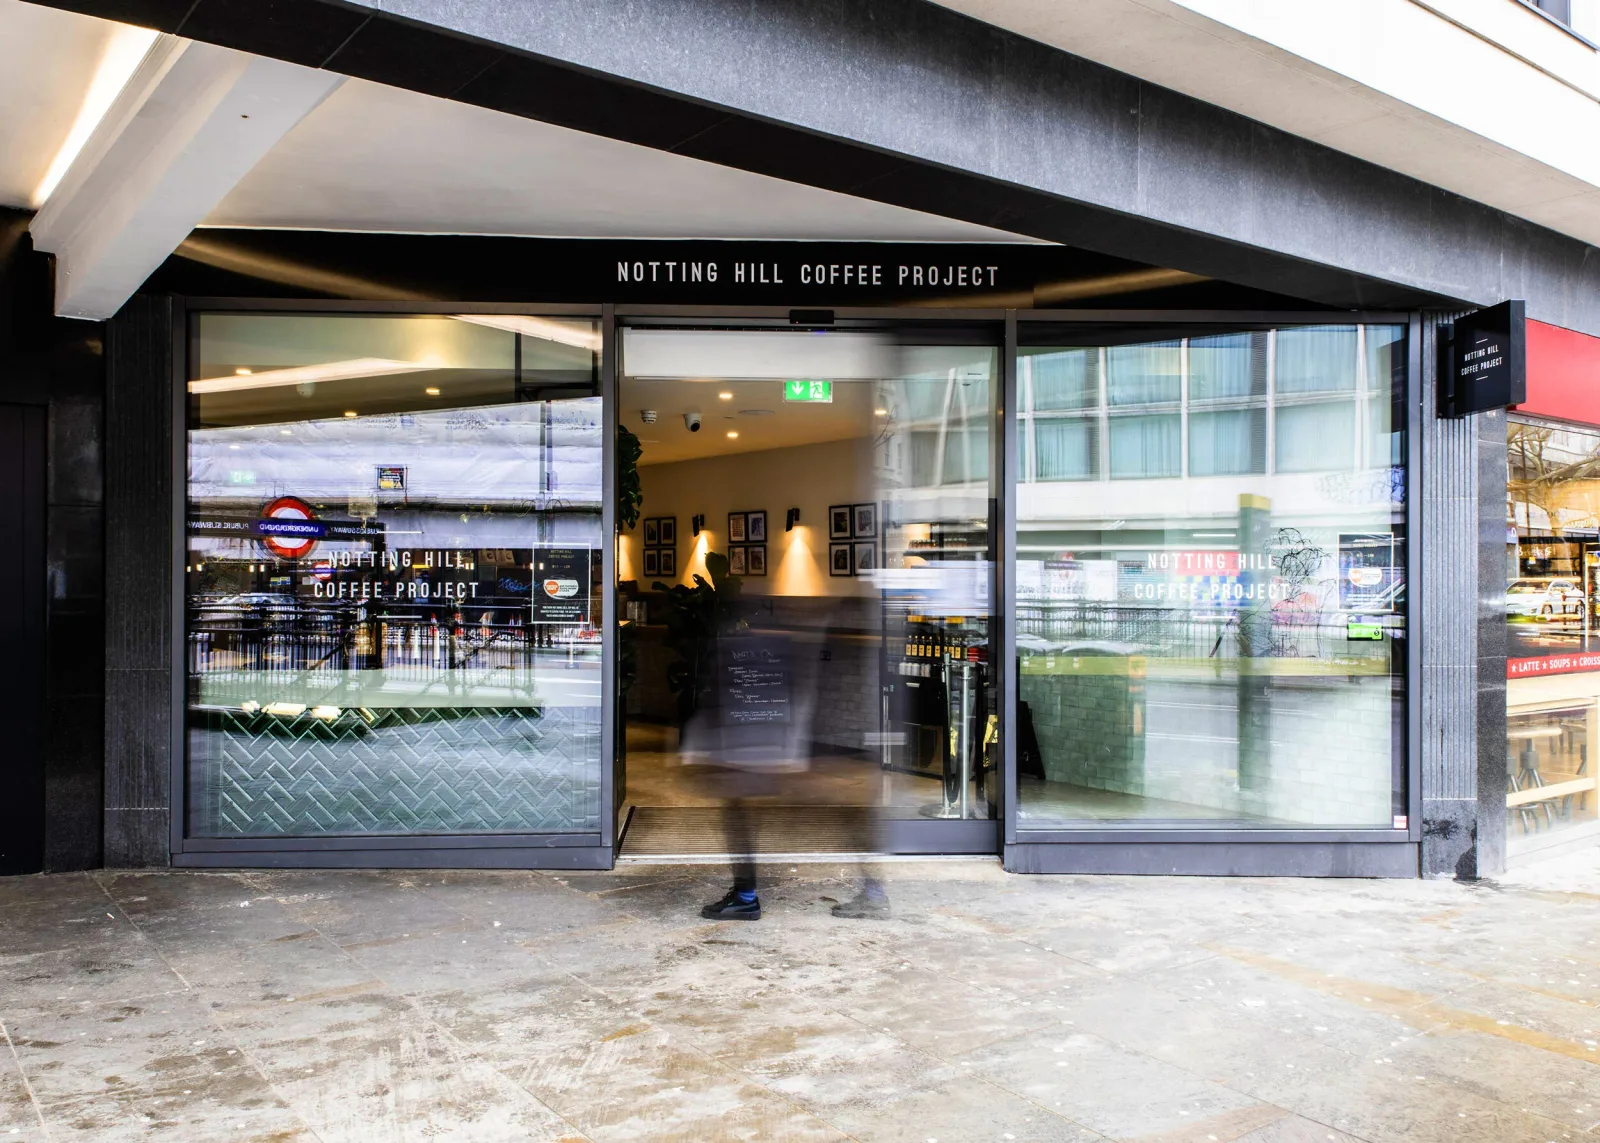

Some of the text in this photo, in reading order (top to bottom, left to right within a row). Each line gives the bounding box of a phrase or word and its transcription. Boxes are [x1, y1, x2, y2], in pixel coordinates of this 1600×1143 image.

[617, 261, 999, 286] NOTTING HILL COFFEE PROJECT
[1464, 344, 1499, 362] NOTTING HILL
[1461, 356, 1503, 376] COFFEE PROJECT
[328, 551, 466, 568] NOTTING HILL
[1147, 553, 1277, 570] NOTTING HILL
[314, 582, 479, 599] COFFEE PROJECT
[1134, 583, 1290, 600] COFFEE PROJECT
[1518, 655, 1600, 673] LATTE SOUPS CROISS
